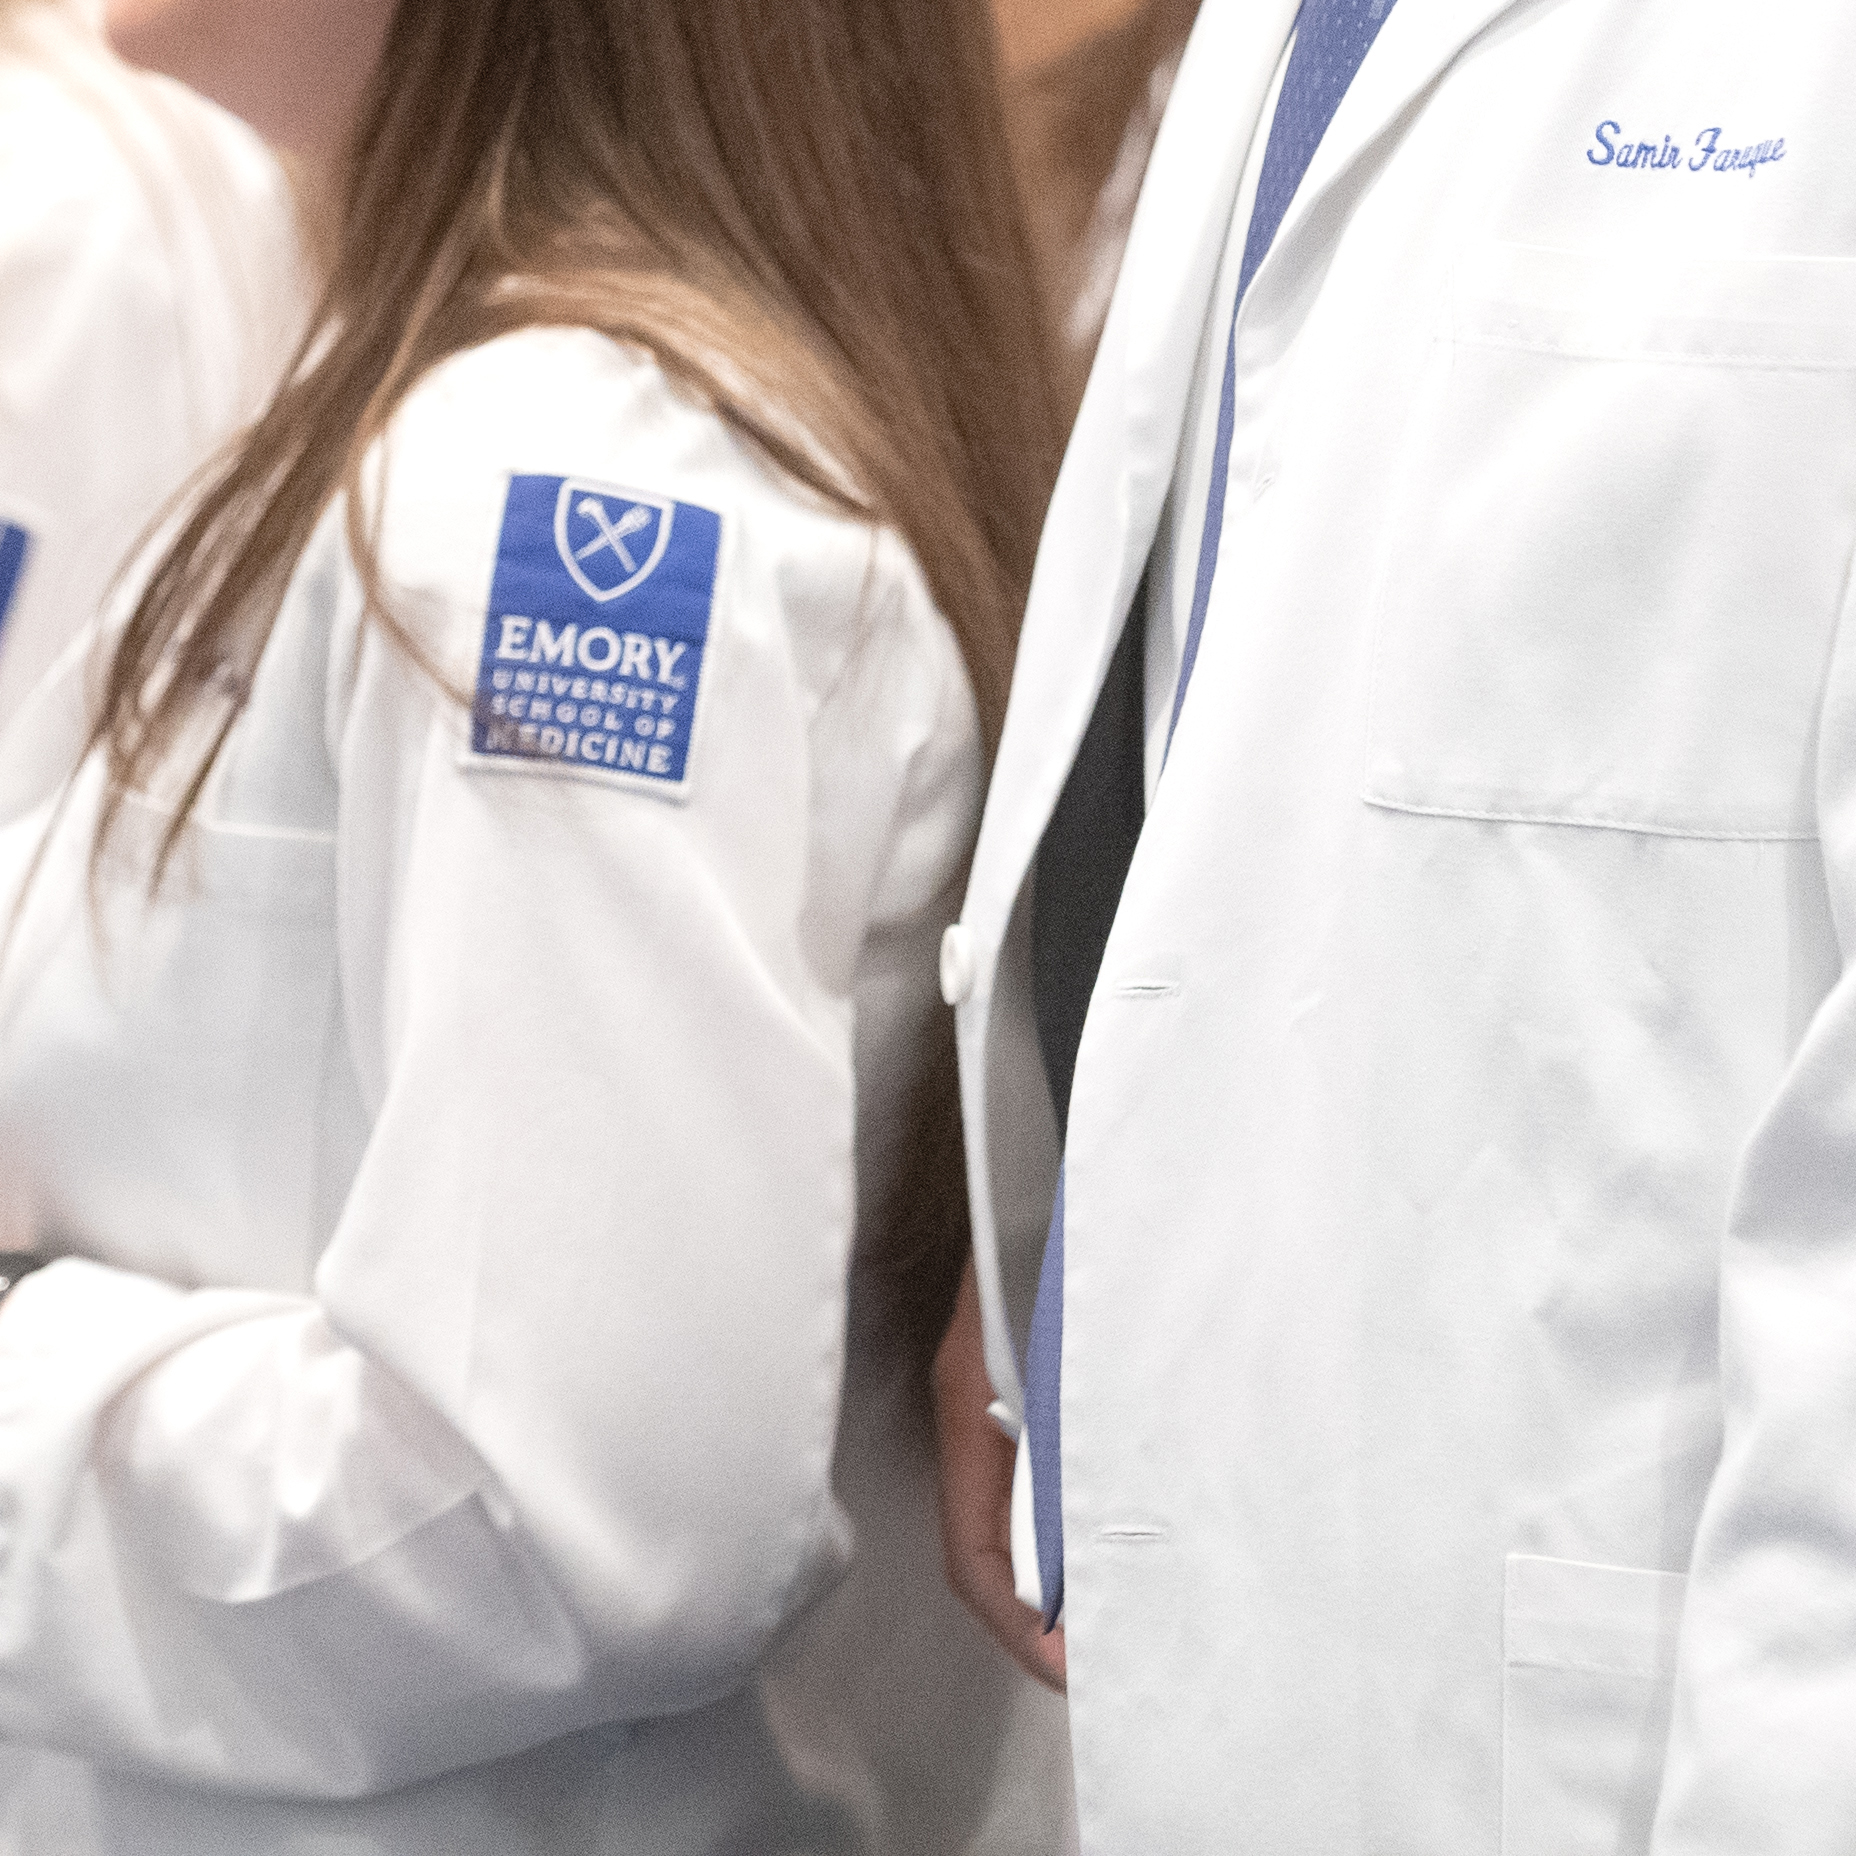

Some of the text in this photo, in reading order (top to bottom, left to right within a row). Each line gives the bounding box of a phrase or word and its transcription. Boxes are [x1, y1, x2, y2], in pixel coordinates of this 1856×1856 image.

[1586, 119, 1683, 170] Samir
[497, 613, 688, 682] EMORY
[492, 668, 680, 715] UNIVERSITY
[492, 693, 677, 741] SCHOOL OF
